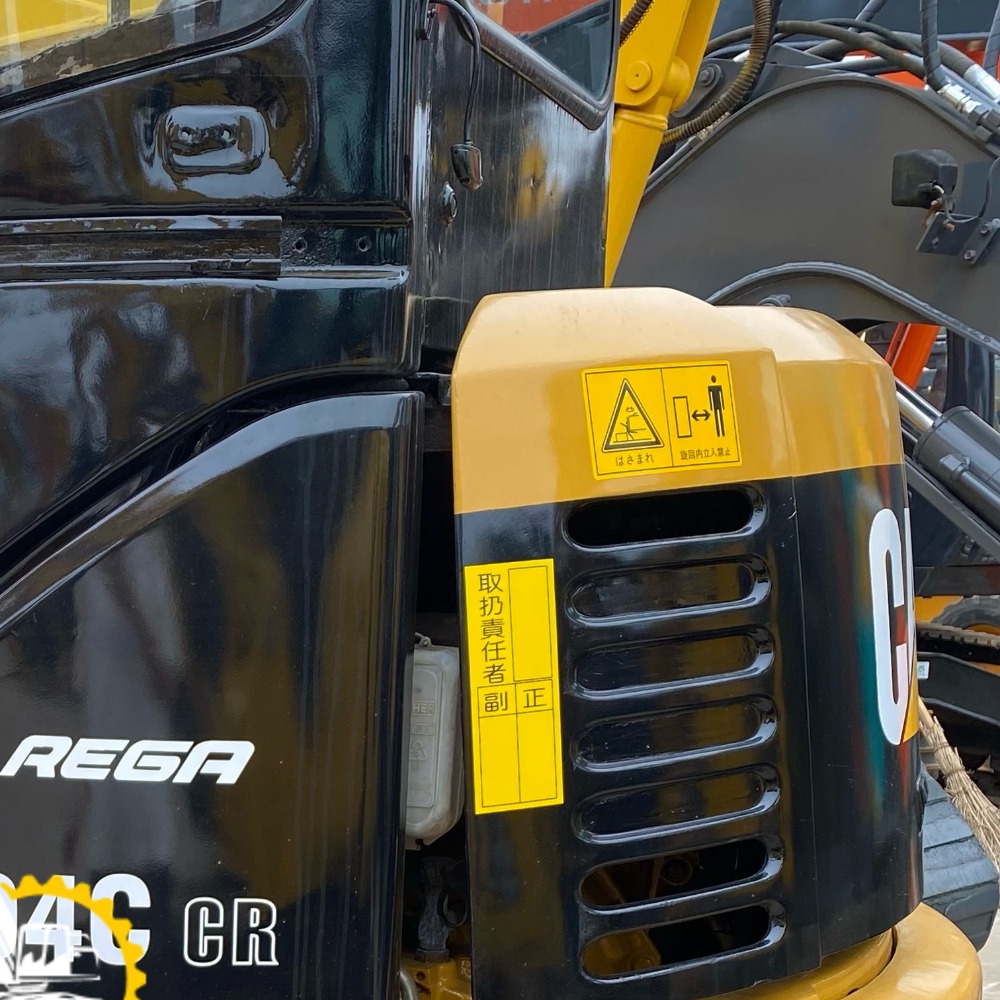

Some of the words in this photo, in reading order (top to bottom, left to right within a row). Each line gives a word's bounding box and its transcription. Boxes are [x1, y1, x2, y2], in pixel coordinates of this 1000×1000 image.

[615, 453, 655, 467] はさまれ
[680, 447, 731, 461] 旋回内立入禁止
[484, 691, 508, 712] 副
[523, 687, 547, 708] 正
[183, 896, 280, 967] CR
